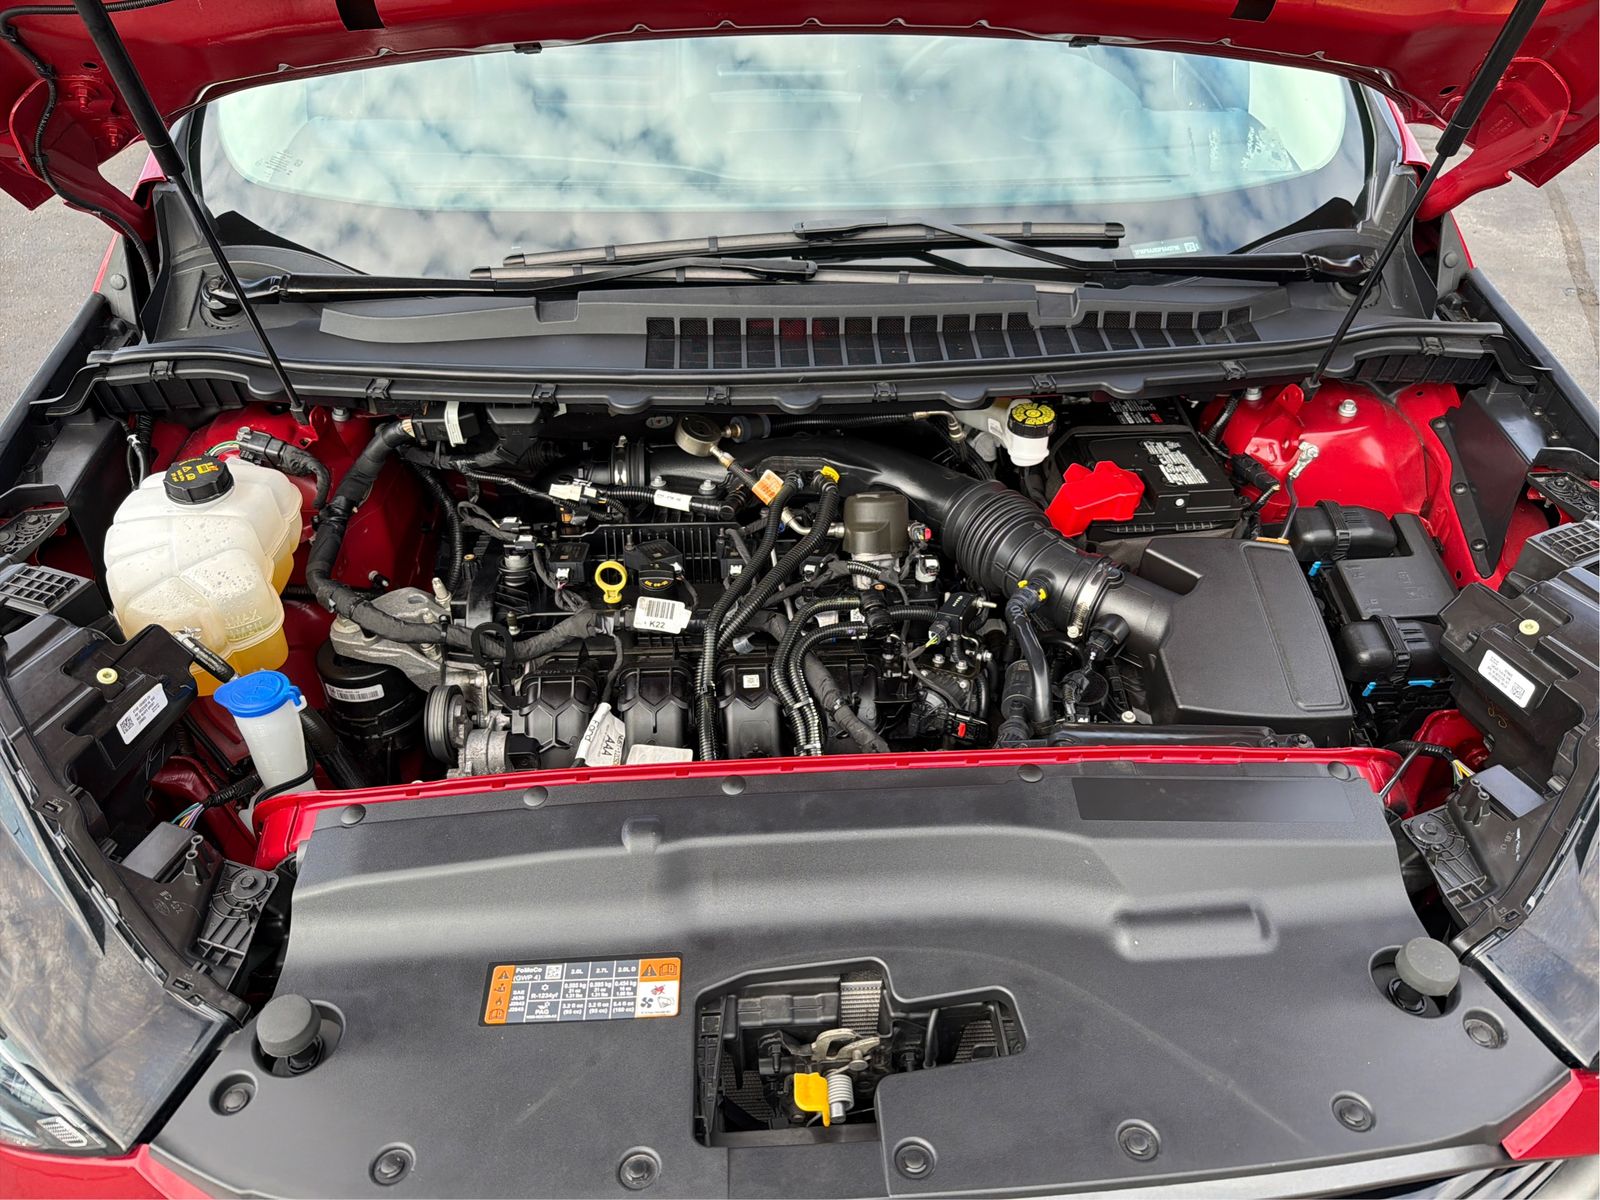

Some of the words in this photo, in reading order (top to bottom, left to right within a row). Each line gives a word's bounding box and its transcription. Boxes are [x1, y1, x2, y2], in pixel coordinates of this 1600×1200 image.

[649, 620, 665, 629] K22
[585, 719, 600, 742] Ford
[601, 734, 615, 756] AAA
[516, 966, 543, 974] FoMoCo
